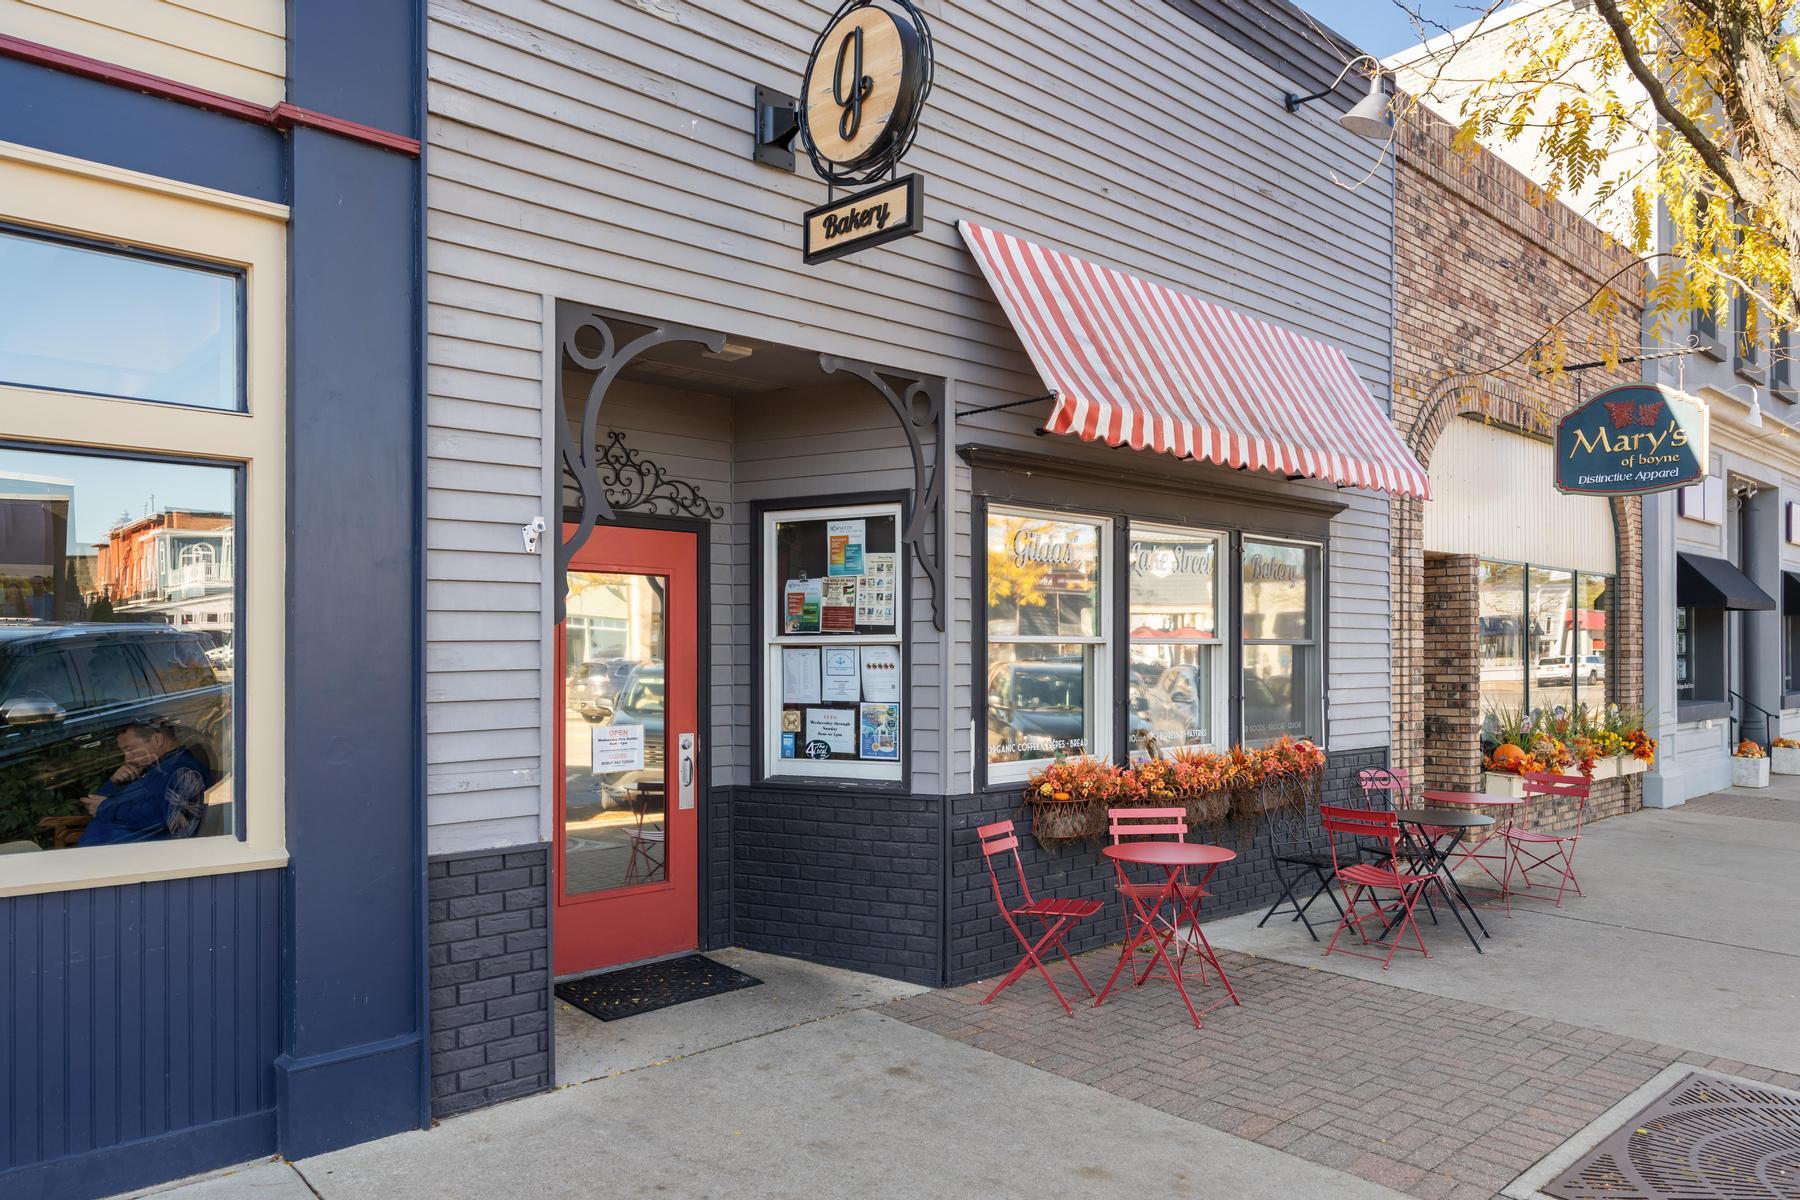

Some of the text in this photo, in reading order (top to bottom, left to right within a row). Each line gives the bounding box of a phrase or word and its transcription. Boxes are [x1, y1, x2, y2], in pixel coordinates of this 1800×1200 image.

[822, 201, 890, 239] Bakery
[1569, 420, 1689, 459] Mary's
[1621, 453, 1681, 469] of boyne
[1578, 467, 1679, 485] Distinctive Apparel
[1017, 743, 1040, 752] COFFEE
[1069, 738, 1089, 748] BREAD
